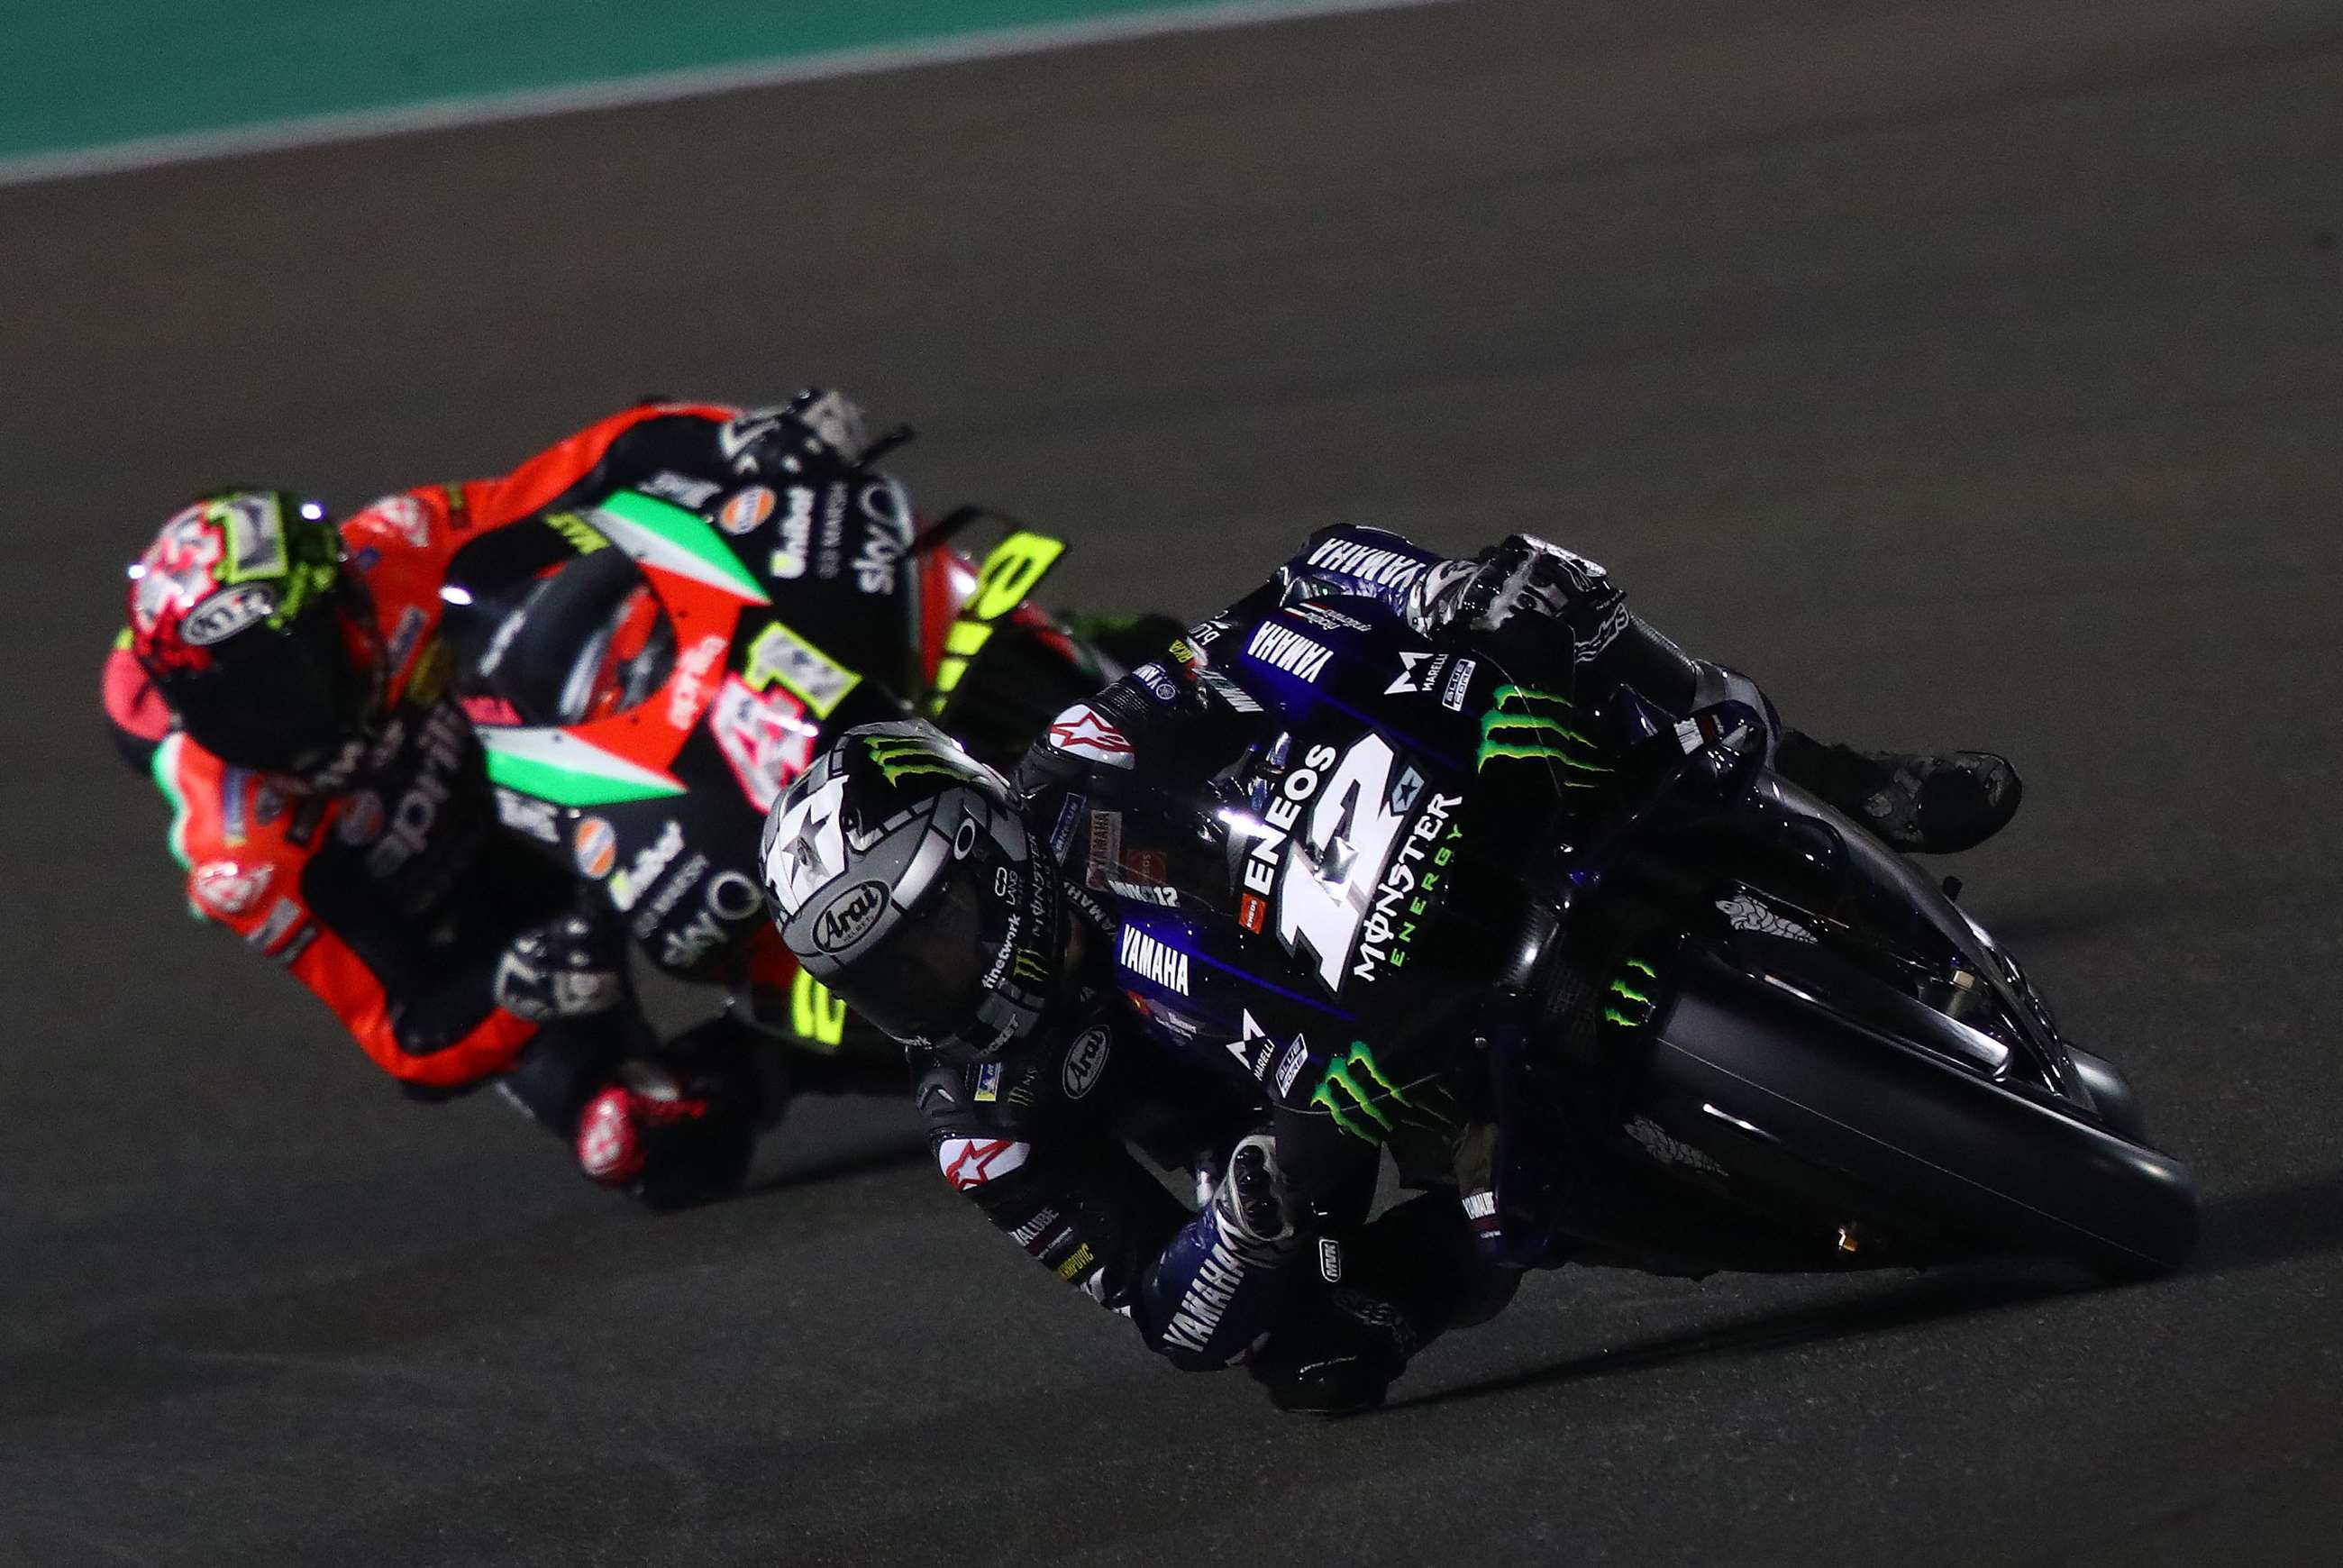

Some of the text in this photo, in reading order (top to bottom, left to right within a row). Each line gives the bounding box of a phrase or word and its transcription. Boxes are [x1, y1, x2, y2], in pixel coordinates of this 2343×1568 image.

[1307, 537, 1427, 593] YAMAHA
[1247, 621, 1334, 684] YAMAHA
[1422, 654, 1449, 691] MARELLI
[1244, 744, 1337, 896] ENEOS
[1279, 732, 1406, 993] 12
[1354, 793, 1463, 982] MONSTER
[1390, 824, 1463, 968] ENERGY
[824, 884, 880, 950] Arai
[1120, 924, 1190, 996] YAMAHA
[1067, 1031, 1107, 1088] Arai
[1254, 1038, 1275, 1081] MARELLI
[1162, 1242, 1245, 1352] YAMAHA
